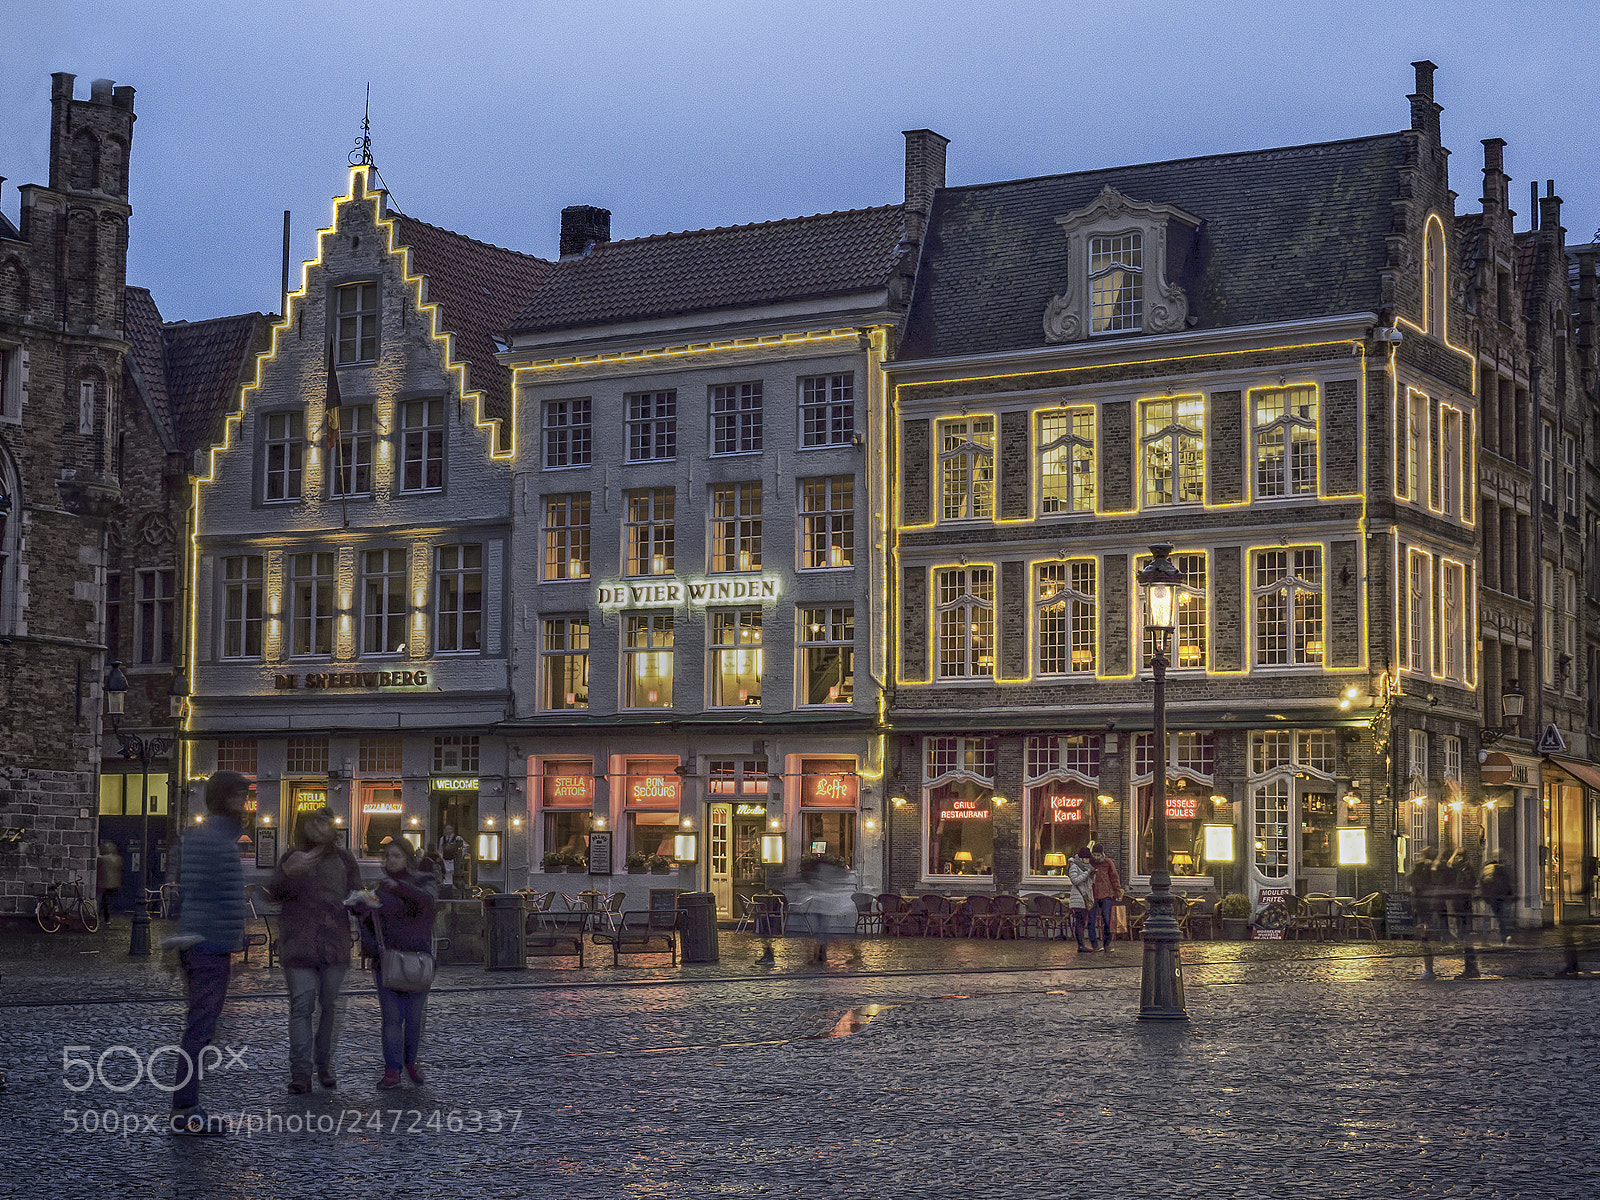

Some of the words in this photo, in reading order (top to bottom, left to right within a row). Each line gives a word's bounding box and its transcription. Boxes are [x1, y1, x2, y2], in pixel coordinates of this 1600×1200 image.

[599, 587, 625, 604] DE
[631, 585, 681, 602] VIER
[688, 580, 776, 600] WINDEN
[436, 779, 479, 789] WELCOME
[555, 777, 585, 787] STELLA
[646, 777, 665, 787] BON
[554, 786, 586, 796] ARTOIS
[815, 778, 848, 799] Leffe
[298, 792, 326, 802] STELLA
[1050, 795, 1083, 809] Keizer
[953, 801, 976, 809] GRILL
[941, 810, 989, 819] RESTAURANT
[1054, 809, 1082, 823] Karel
